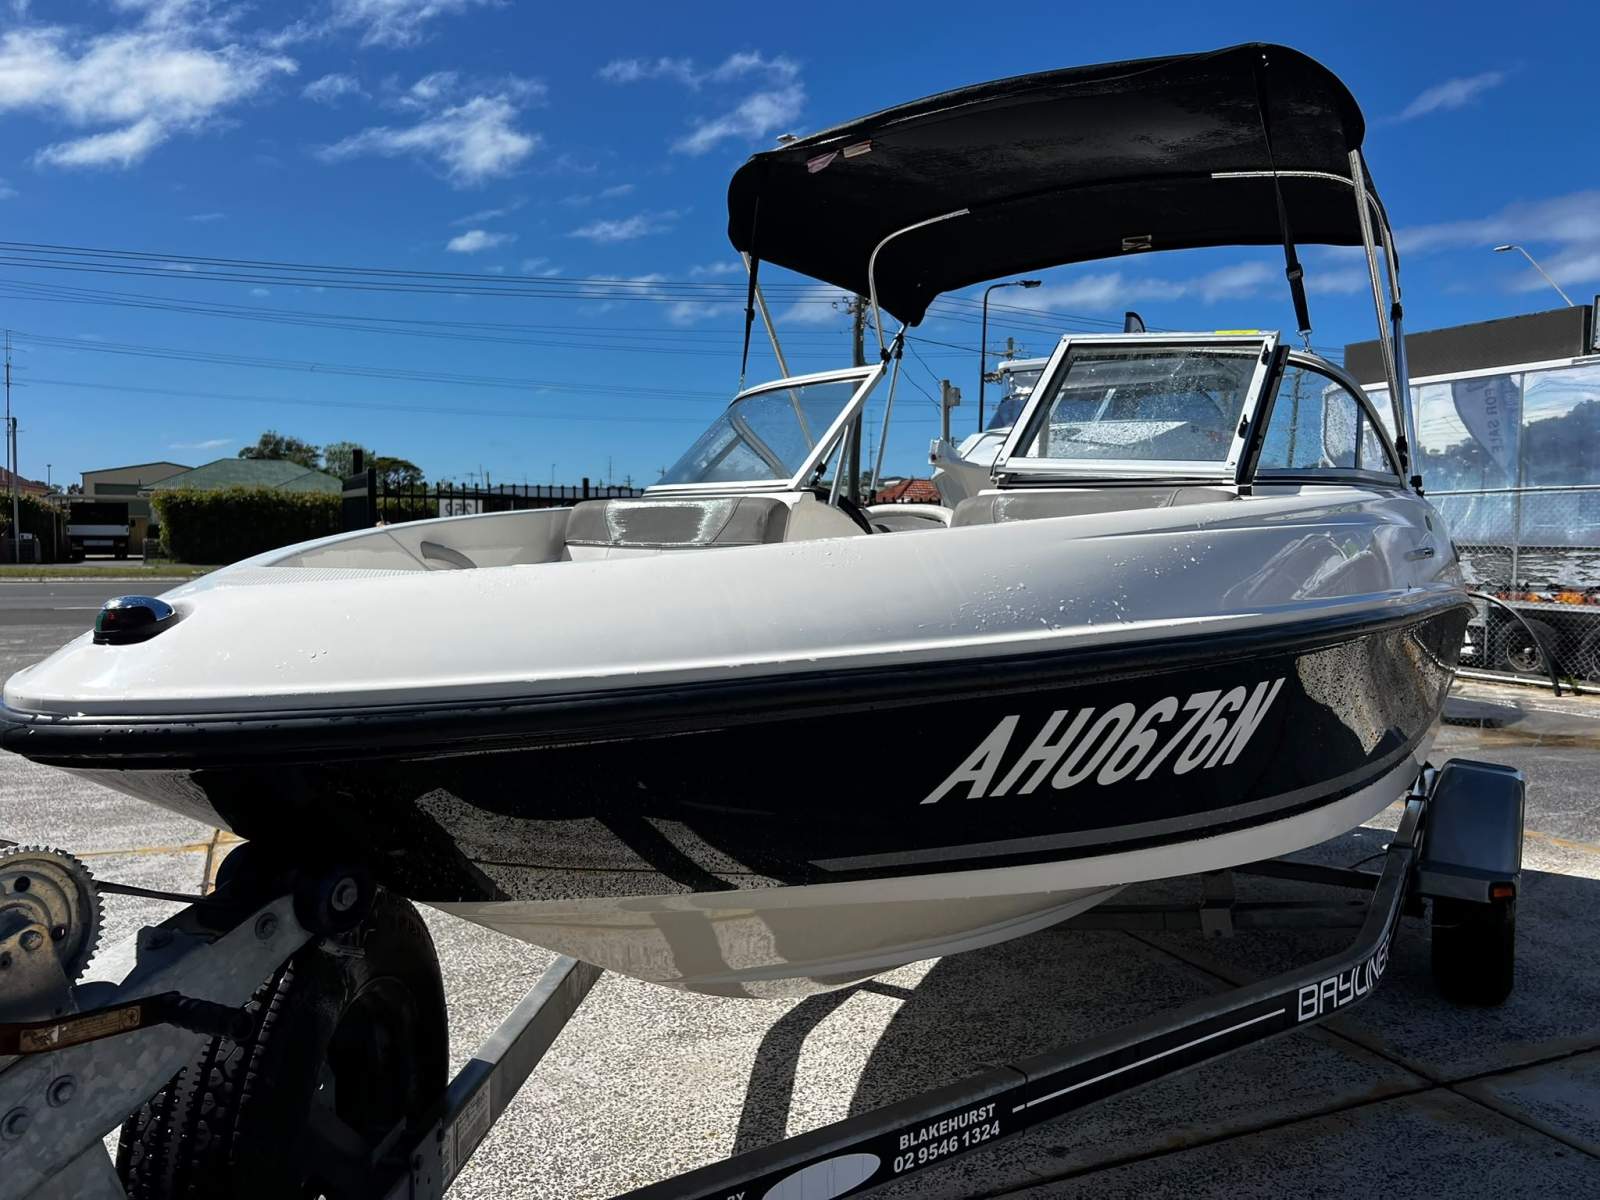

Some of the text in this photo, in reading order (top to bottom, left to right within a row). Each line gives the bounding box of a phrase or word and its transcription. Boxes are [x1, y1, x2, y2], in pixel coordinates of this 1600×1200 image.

[894, 1120, 1000, 1173] 02 9546 1324
[900, 1103, 995, 1150] BLAKEHURST
